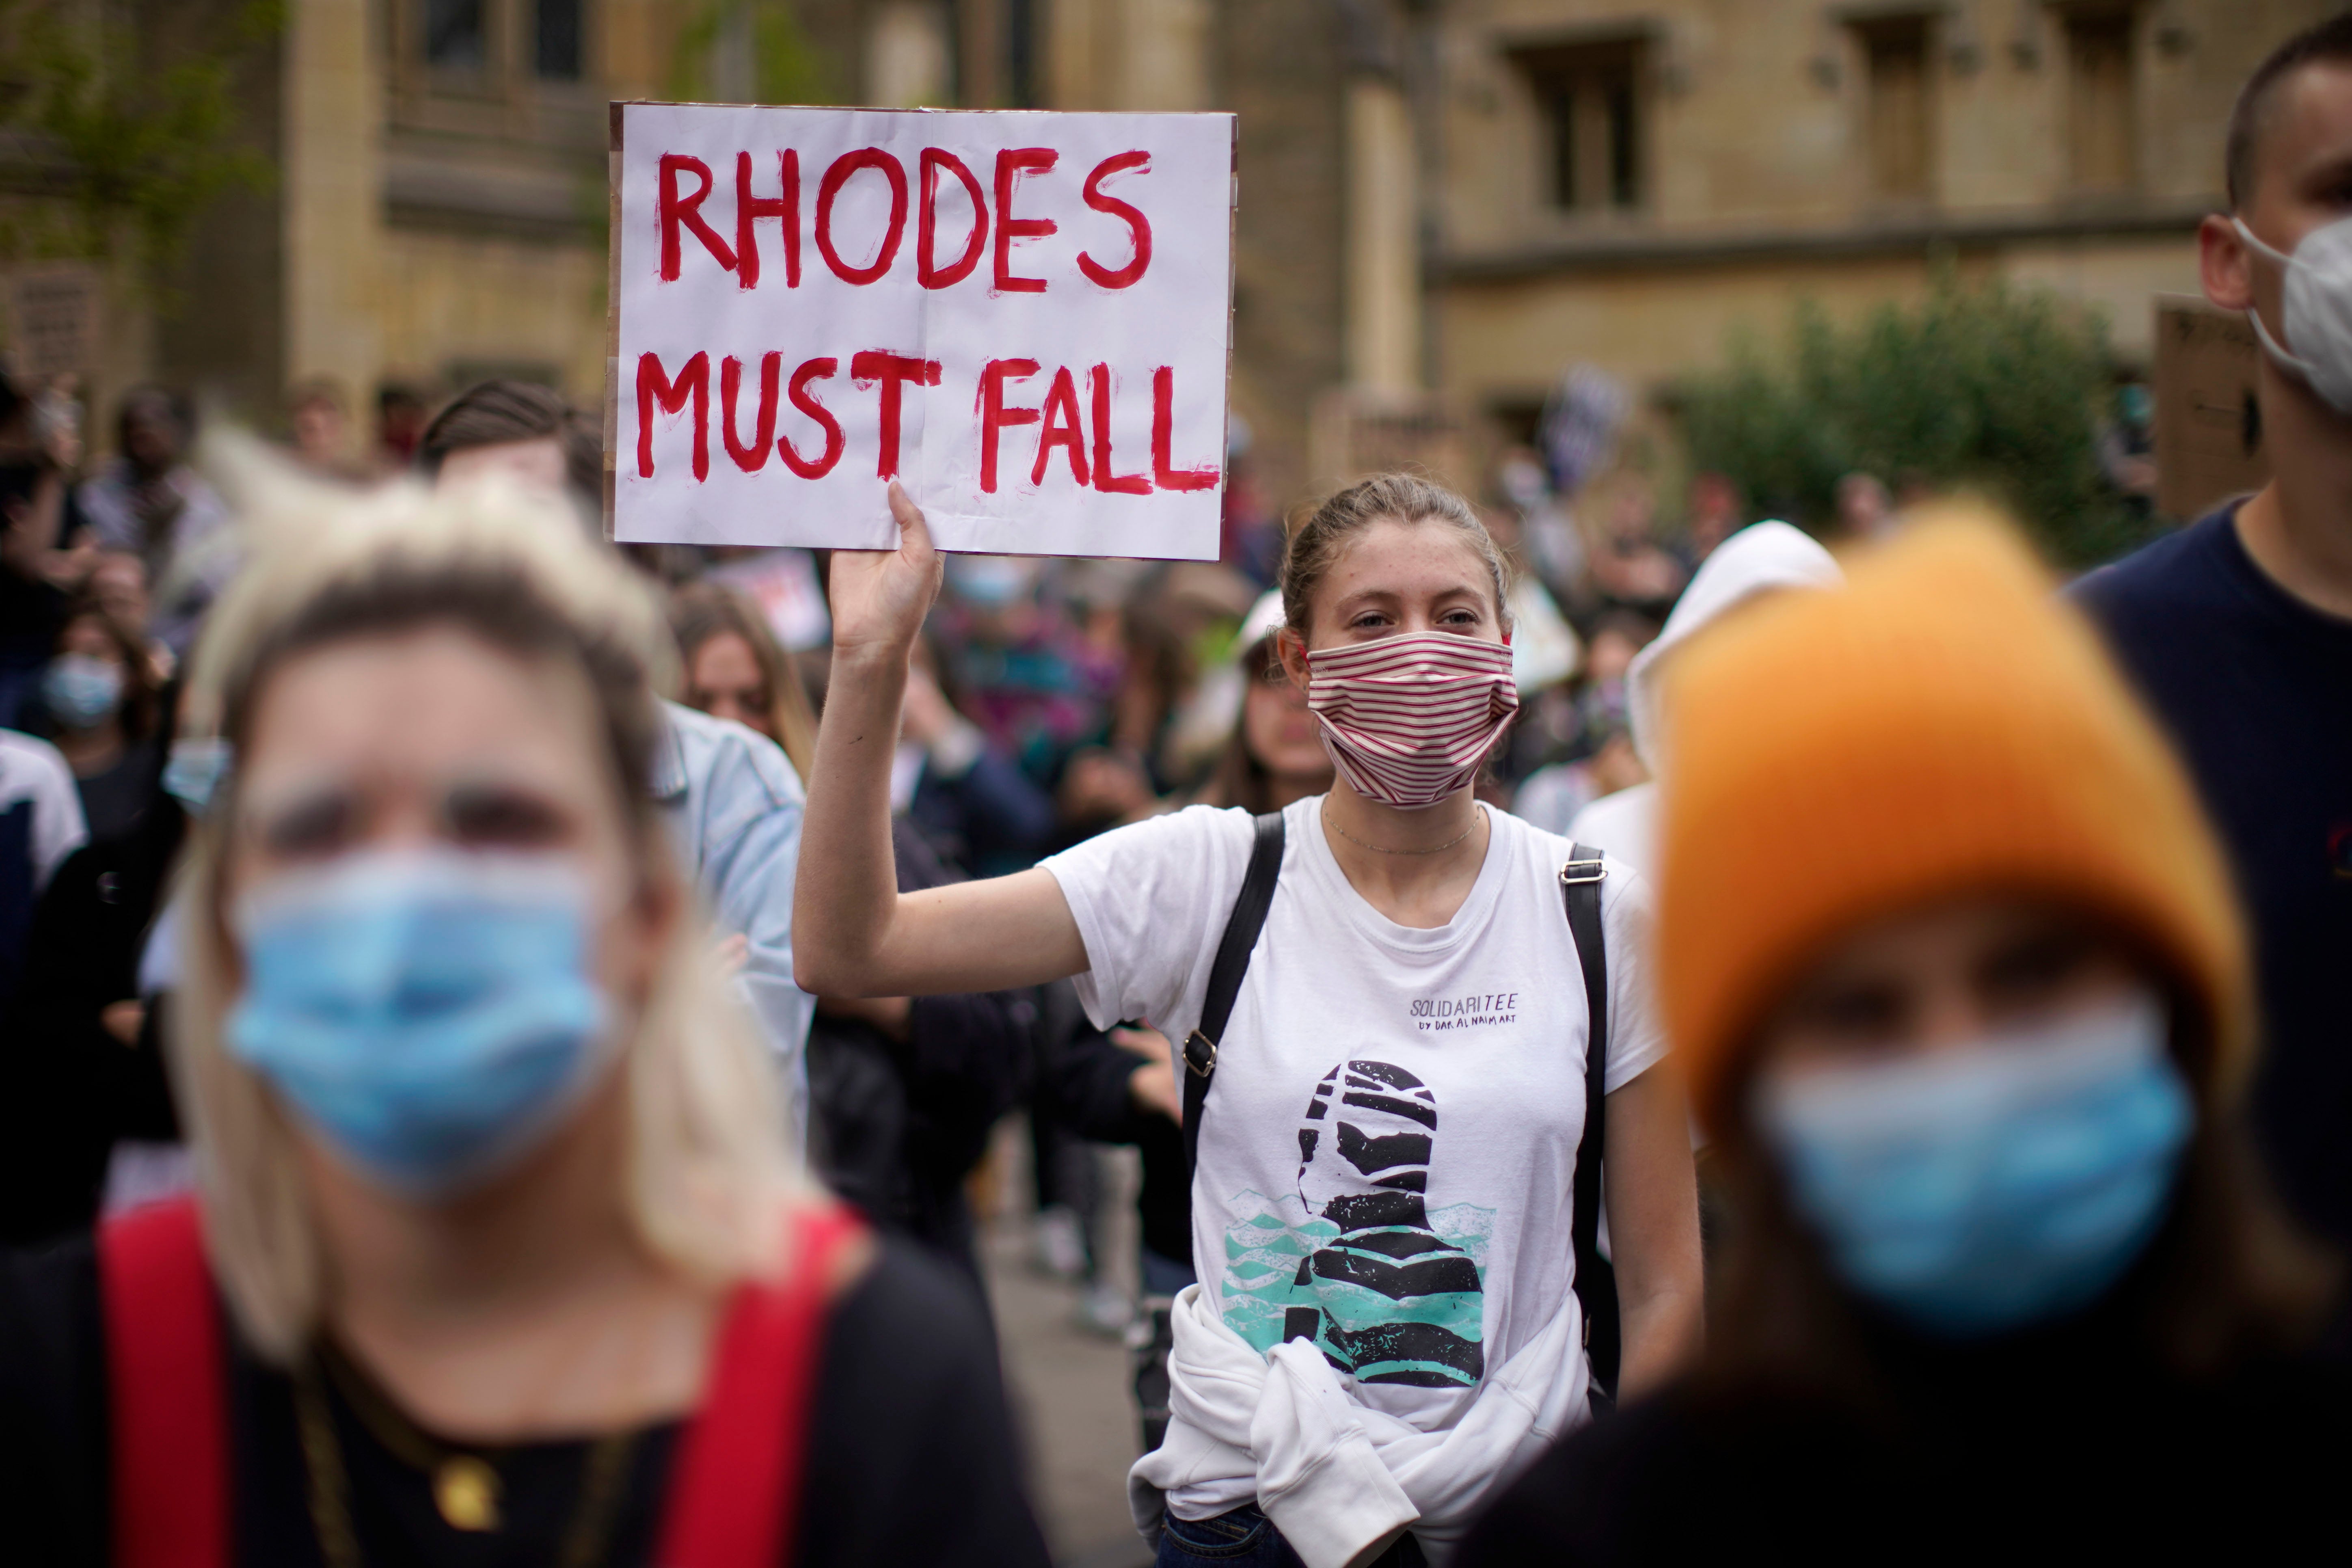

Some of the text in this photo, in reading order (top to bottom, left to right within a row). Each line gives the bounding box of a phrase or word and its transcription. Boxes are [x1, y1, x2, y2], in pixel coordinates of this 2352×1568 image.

[657, 146, 1153, 293] RHODES
[635, 348, 1220, 496] MUST FALL
[1410, 993, 1518, 1017] SOLIDARITEE
[1419, 1015, 1516, 1030] BY DAR AL NAIM ART
